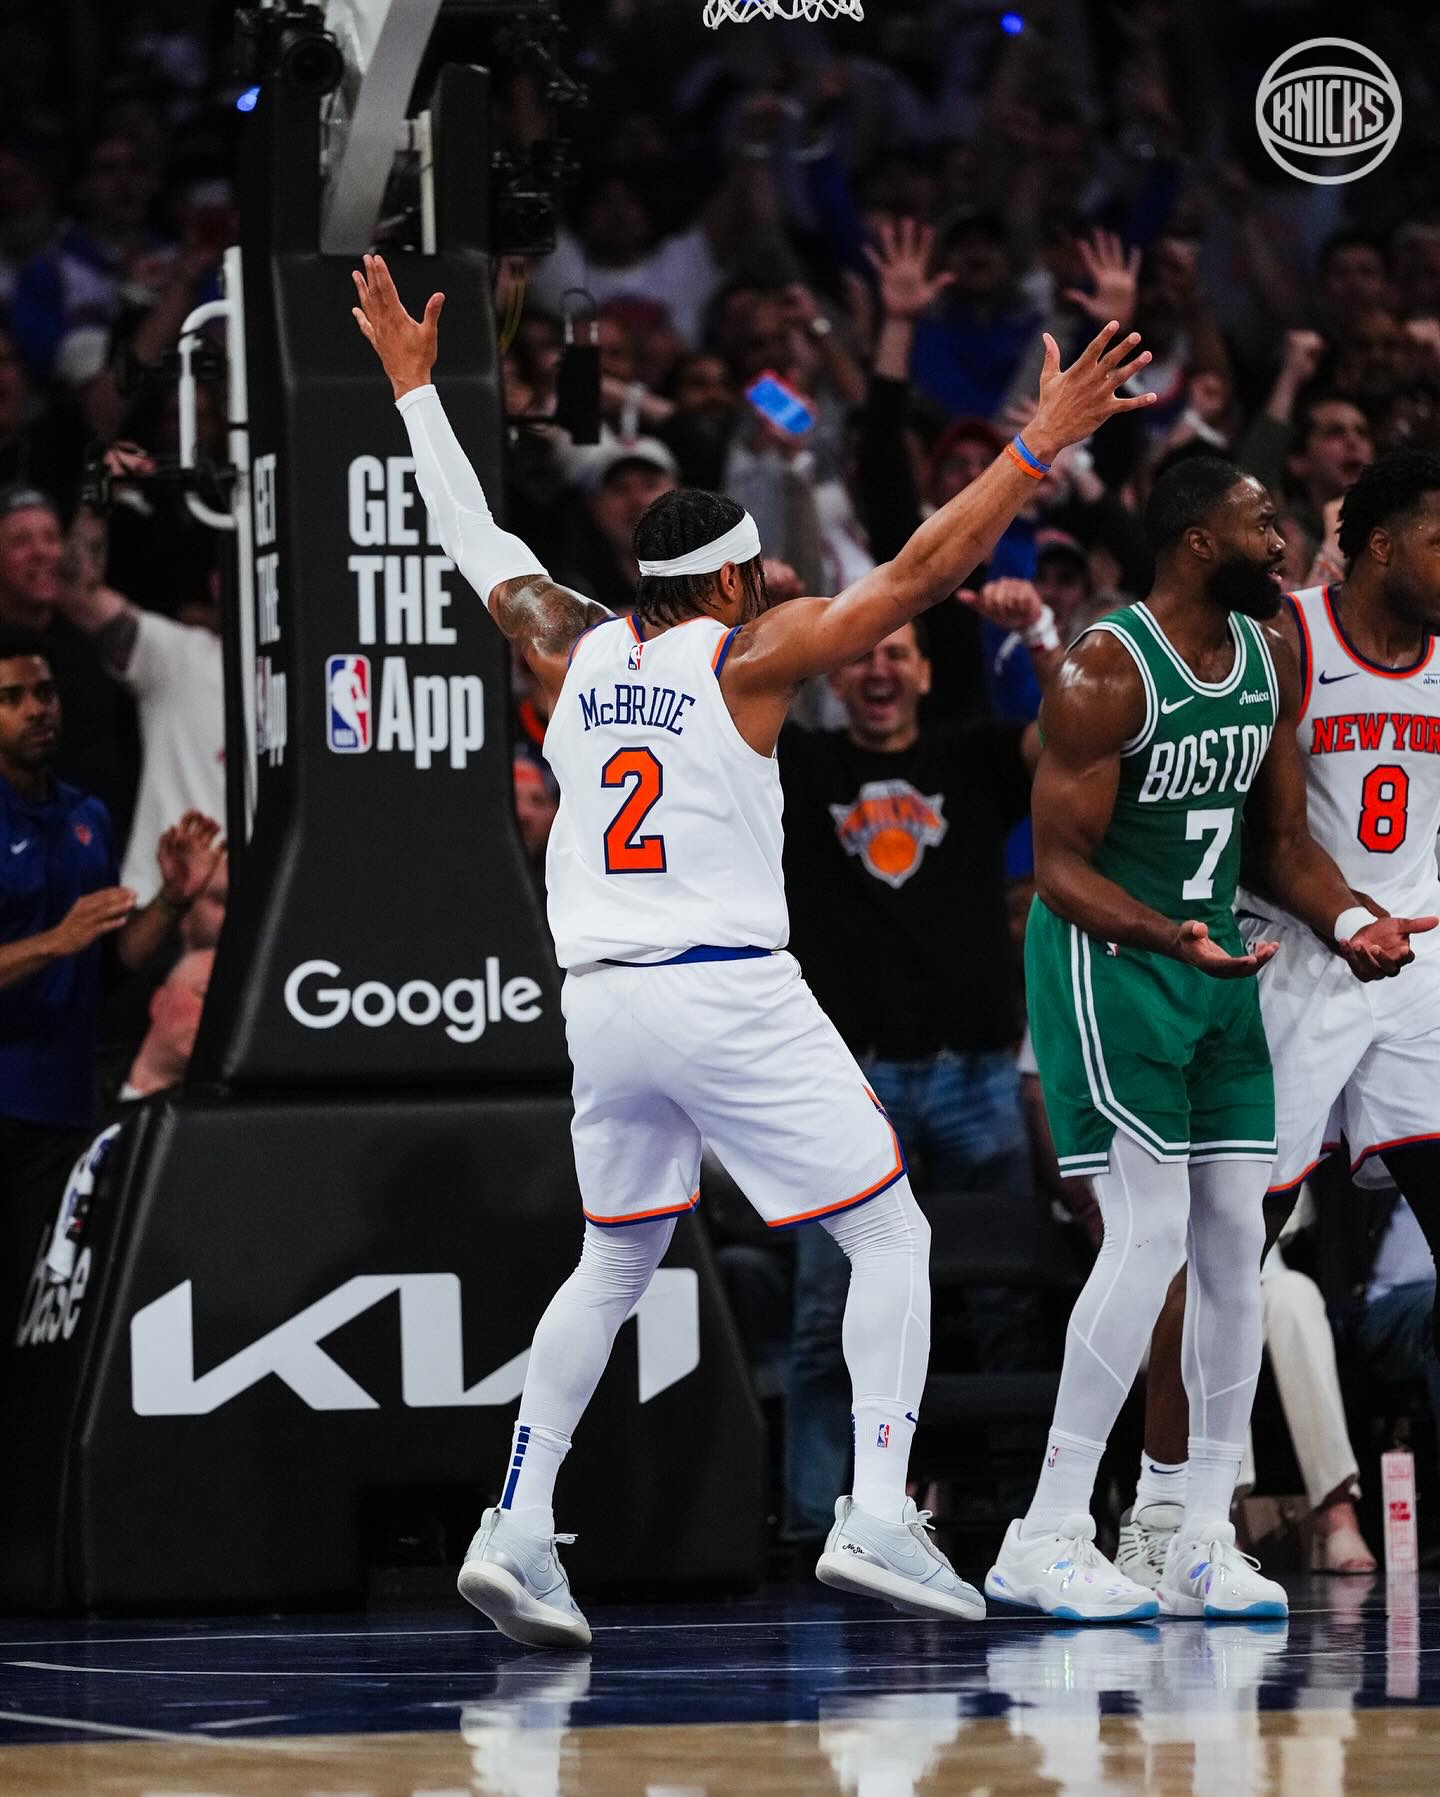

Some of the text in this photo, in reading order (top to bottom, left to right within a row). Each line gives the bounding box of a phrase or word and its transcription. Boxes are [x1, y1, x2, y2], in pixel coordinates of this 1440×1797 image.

[348, 455, 441, 546] GE
[348, 555, 457, 645] THE
[377, 656, 485, 770] App
[578, 684, 696, 736] McBRIDE
[1239, 689, 1270, 706] Amica
[1311, 712, 1388, 755] NEW
[600, 746, 667, 875] 2
[1182, 807, 1235, 901] 7
[1357, 764, 1410, 854] 8
[284, 956, 543, 1044] Google
